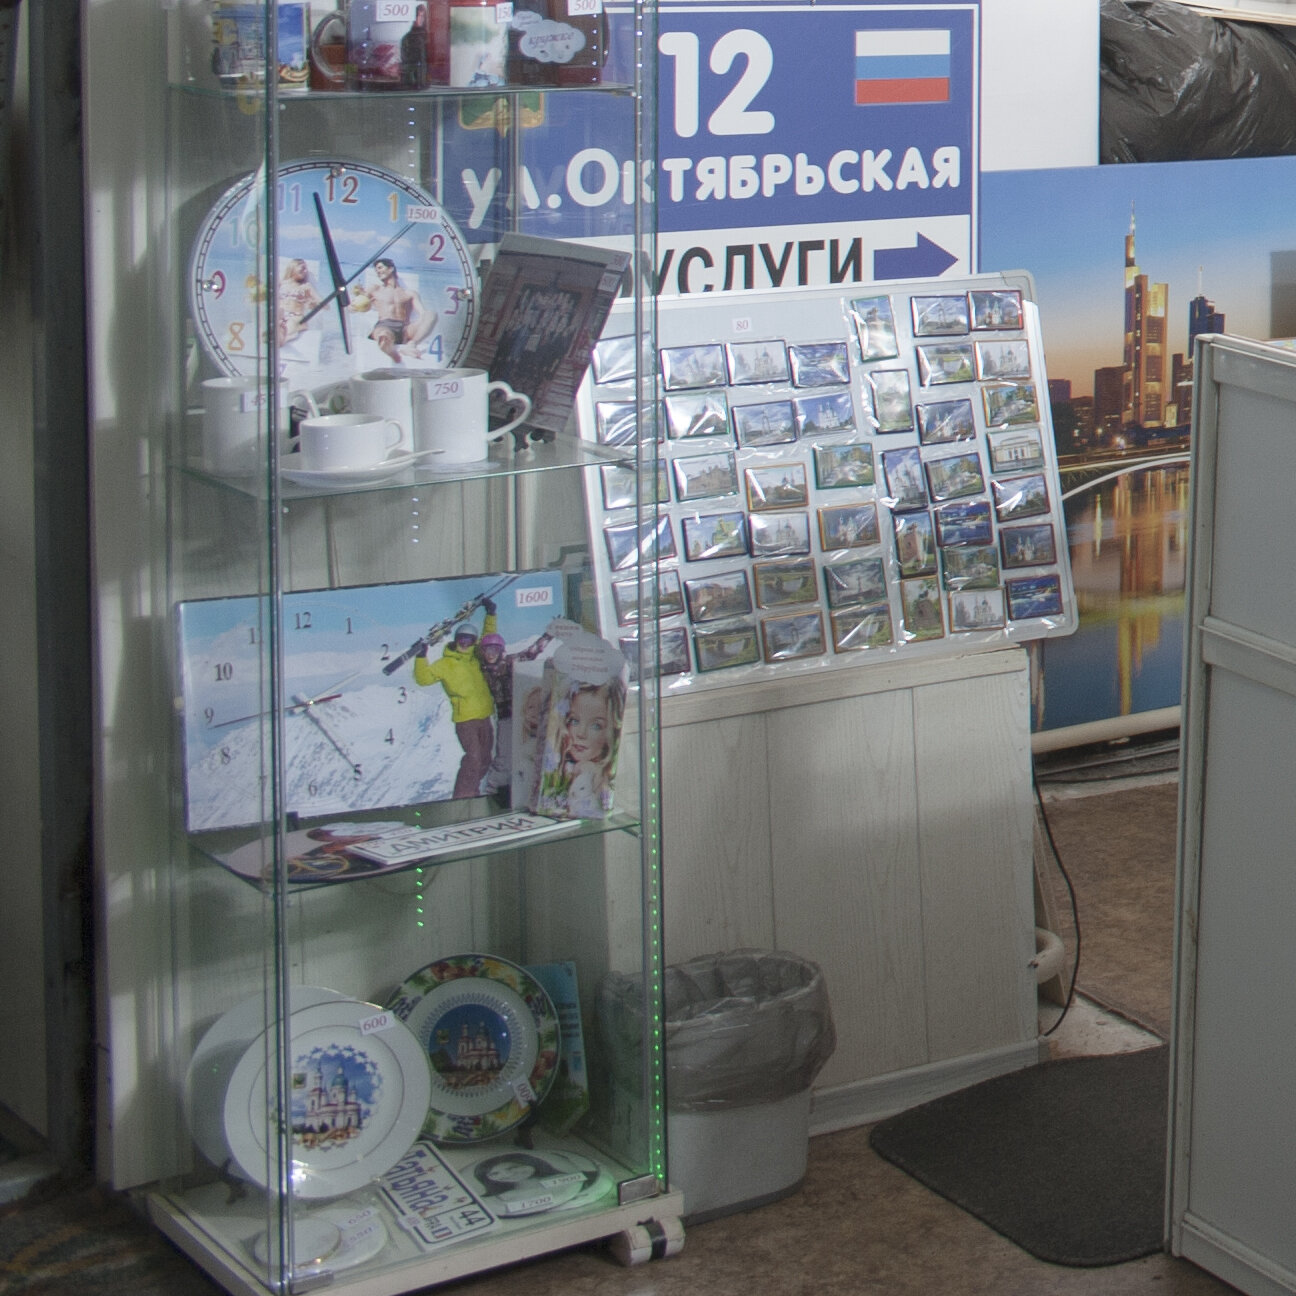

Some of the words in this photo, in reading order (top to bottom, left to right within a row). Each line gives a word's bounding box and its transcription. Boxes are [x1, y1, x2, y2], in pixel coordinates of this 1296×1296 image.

[383, 3, 409, 17] 500
[659, 29, 777, 139] 12
[326, 176, 359, 204] 12
[388, 193, 398, 221] 1
[407, 206, 437, 220] 1500
[429, 234, 445, 261] 2
[444, 287, 460, 314] 3
[736, 319, 749, 331] 80
[228, 321, 245, 350] 8
[429, 334, 444, 362] 4
[433, 381, 459, 395] 750
[519, 589, 549, 604] 1600
[294, 612, 311, 629] 12
[345, 617, 353, 634] 1
[380, 644, 389, 662] 2
[214, 663, 233, 681] 10
[398, 686, 407, 705] 3
[204, 707, 214, 724] 9
[384, 728, 395, 746] 4
[220, 747, 231, 764] 8
[391, 817, 535, 853] ДМИТРИЙ
[362, 1015, 388, 1032] 600
